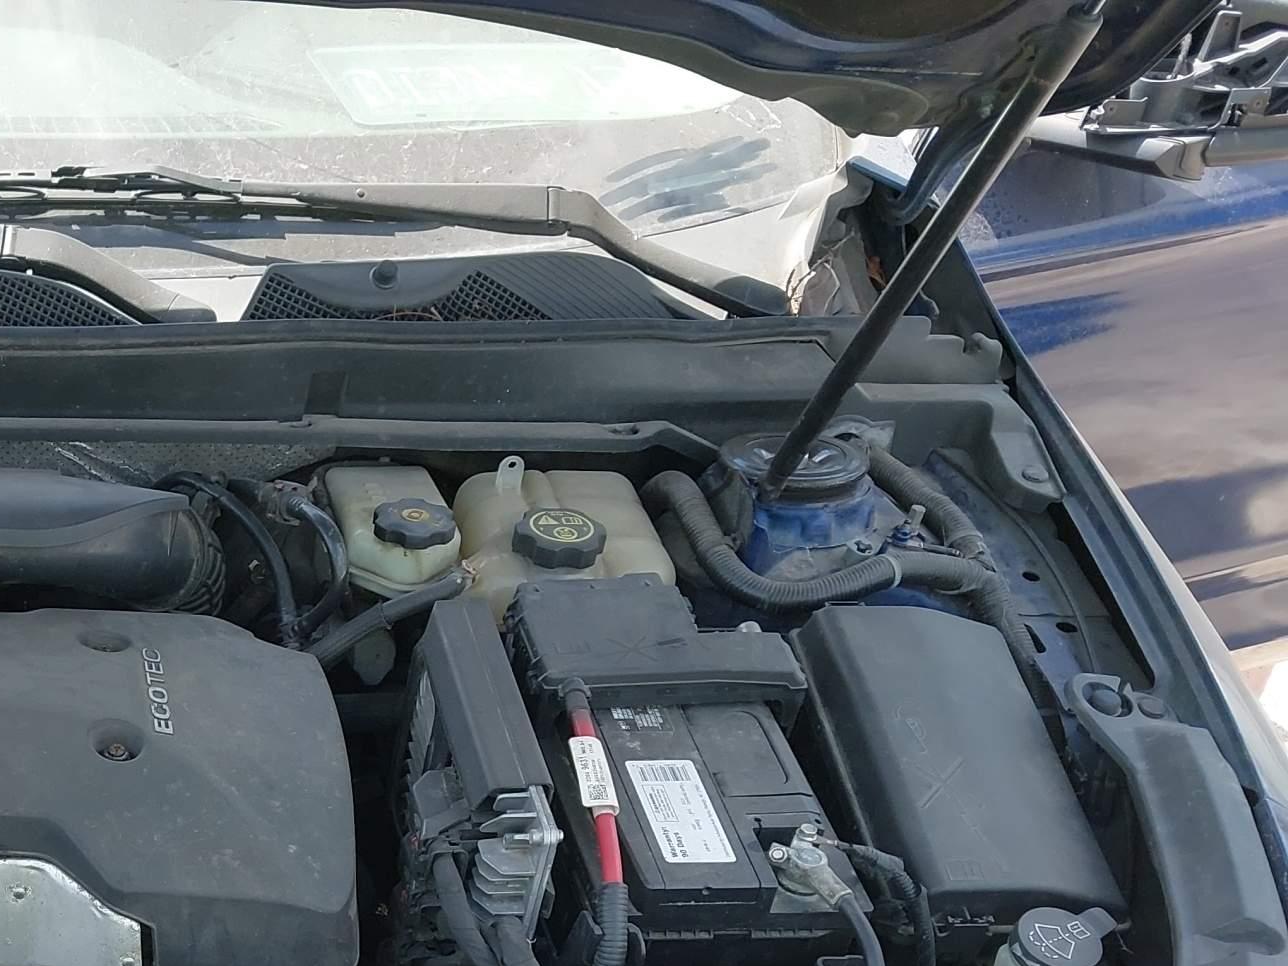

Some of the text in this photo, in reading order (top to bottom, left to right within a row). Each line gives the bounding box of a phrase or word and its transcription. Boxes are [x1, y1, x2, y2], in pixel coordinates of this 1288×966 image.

[142, 647, 174, 735] ECOTEC
[673, 832, 689, 858] 90 Days
